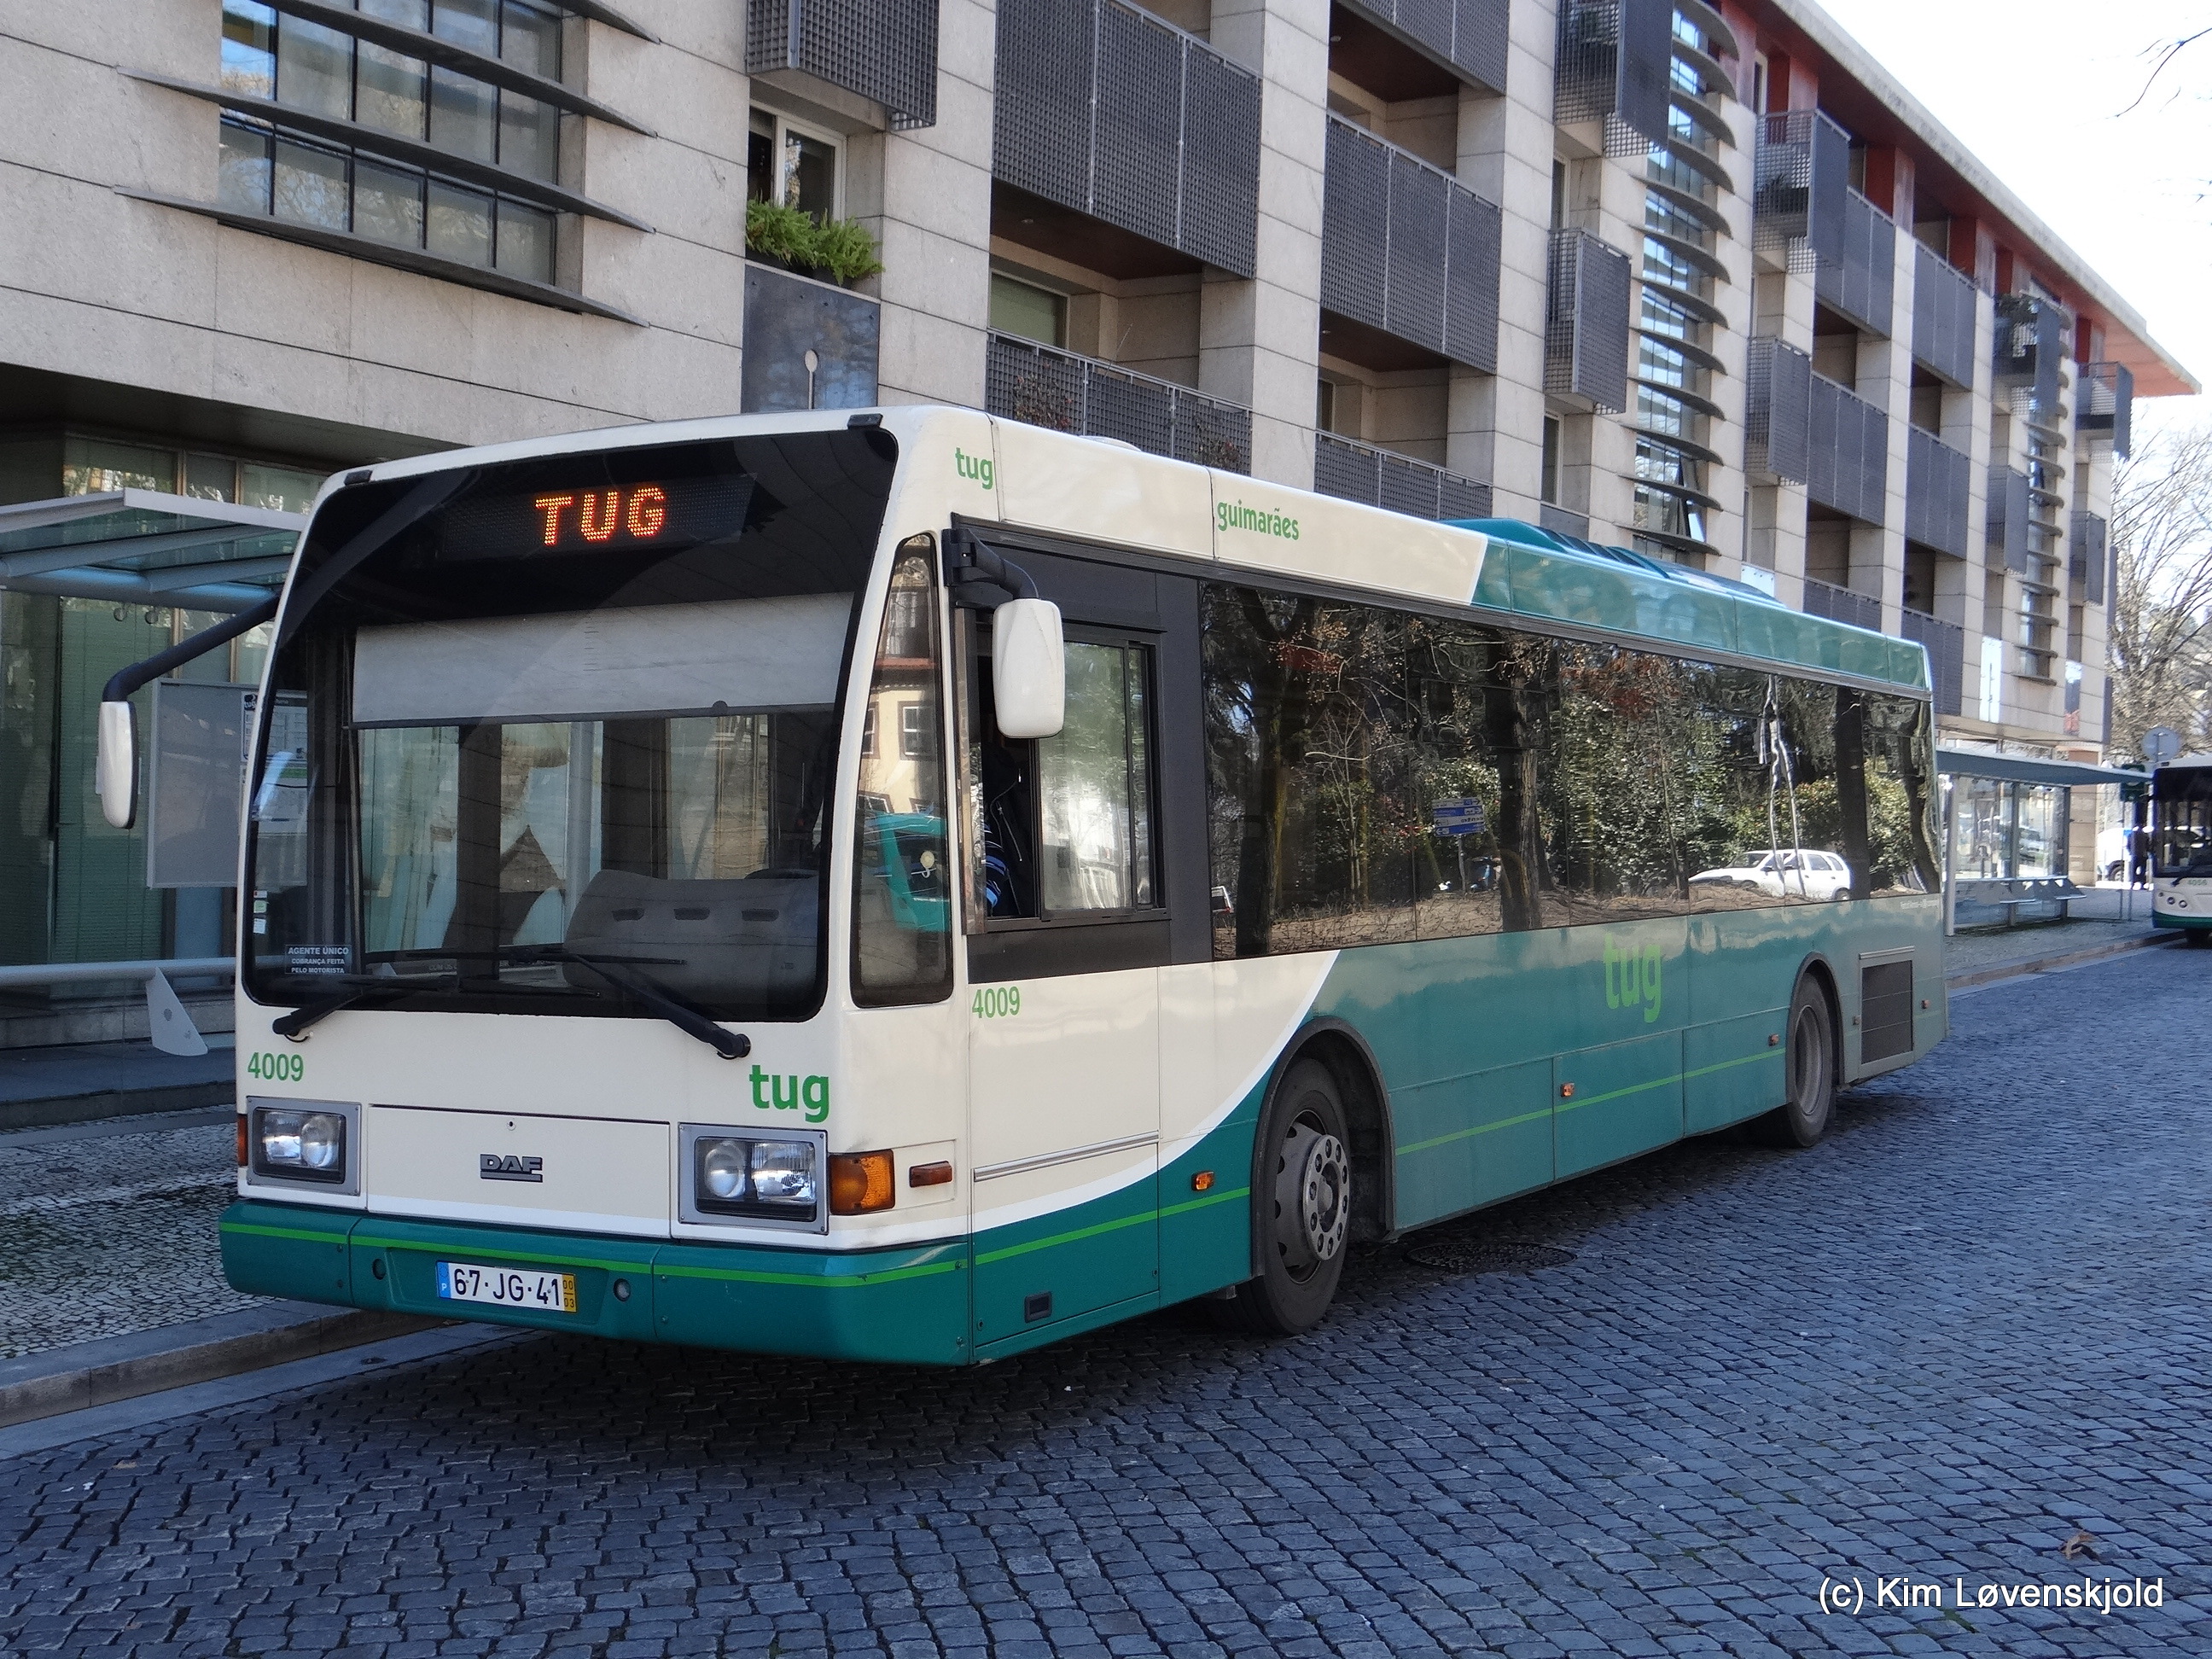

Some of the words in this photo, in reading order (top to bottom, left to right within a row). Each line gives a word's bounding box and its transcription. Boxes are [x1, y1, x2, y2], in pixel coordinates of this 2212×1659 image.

[955, 447, 992, 490] tug
[535, 486, 665, 545] TUG
[1217, 499, 1299, 540] guimarães
[323, 946, 349, 955] ÚNICO
[1604, 932, 1662, 1022] tug
[972, 987, 1020, 1018] 4009
[247, 1052, 304, 1081] 4009
[749, 1065, 830, 1123] tug
[480, 1154, 543, 1175] DAF
[562, 1280, 573, 1290] 00
[563, 1298, 575, 1308] 03
